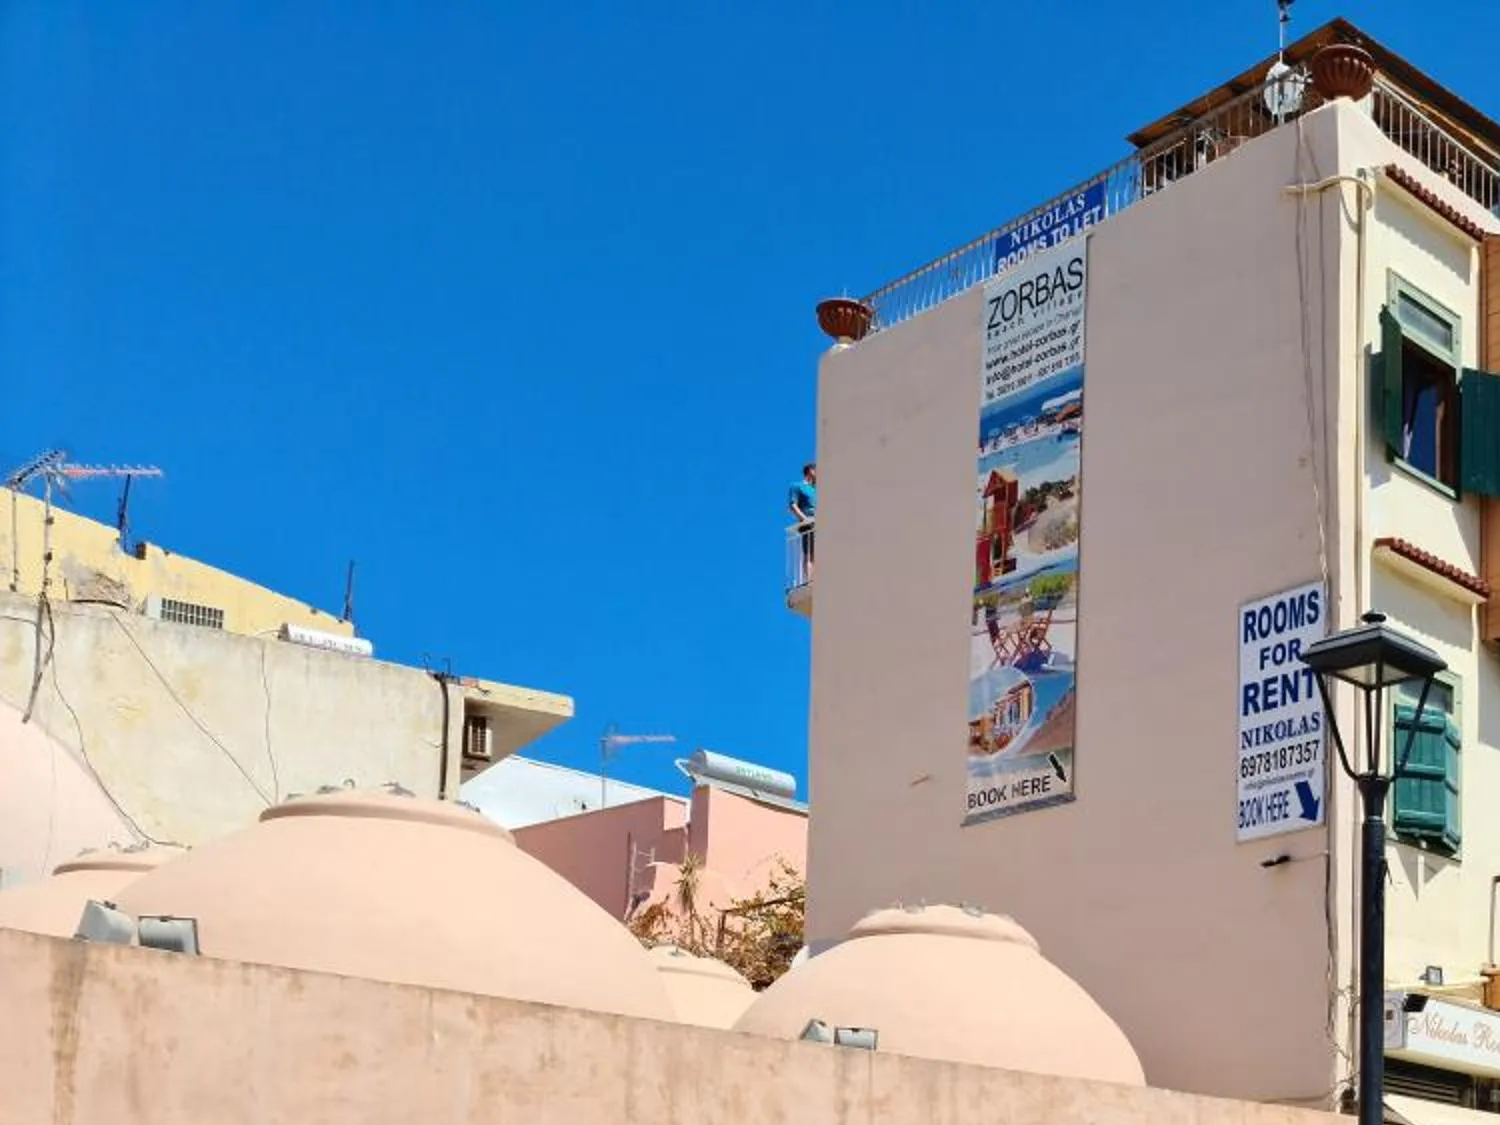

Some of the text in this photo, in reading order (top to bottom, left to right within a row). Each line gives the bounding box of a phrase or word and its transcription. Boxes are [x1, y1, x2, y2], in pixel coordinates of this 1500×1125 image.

[1010, 193, 1087, 247] NIKOLAS
[1052, 223, 1070, 248] TO
[1071, 206, 1102, 237] LET
[987, 256, 1084, 331] ZORBAS
[1243, 589, 1320, 644] ROOMS
[1259, 637, 1301, 670] FOR
[1242, 666, 1315, 716] RENT
[1241, 711, 1321, 749] NIKOLAS
[1241, 740, 1320, 779] 6978187357
[967, 775, 1051, 809] BOOK HERE
[1238, 789, 1290, 829] BOOK HERE
